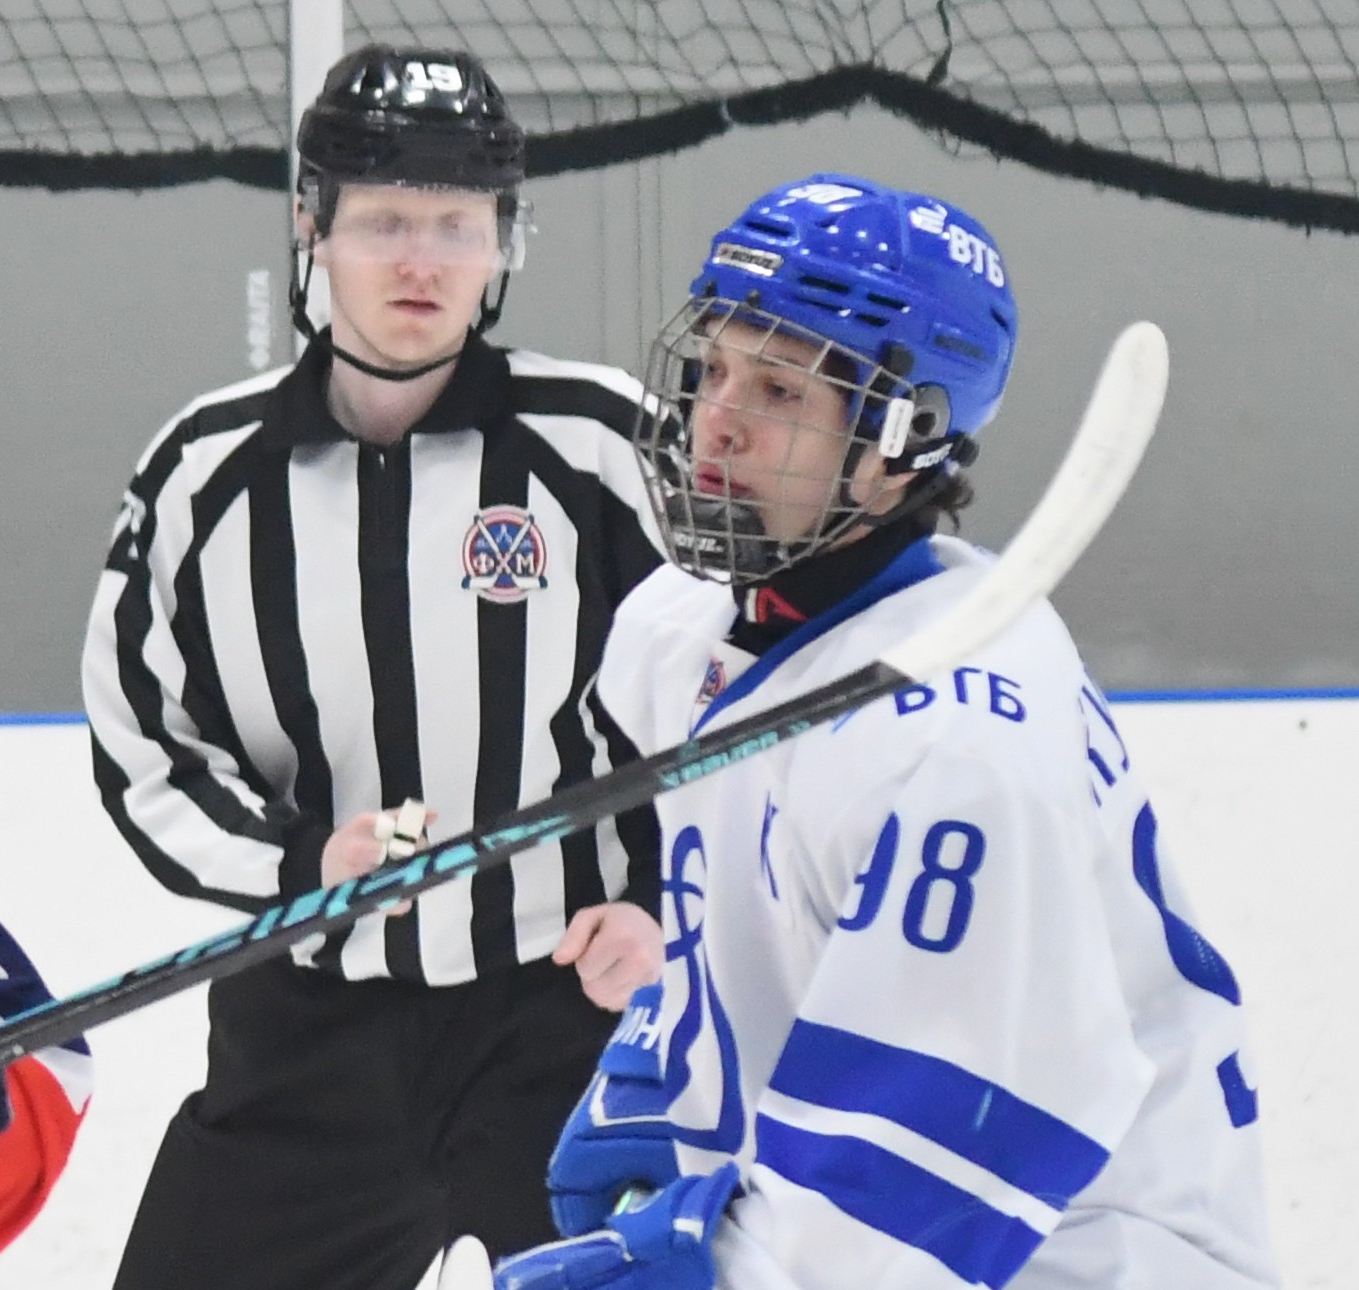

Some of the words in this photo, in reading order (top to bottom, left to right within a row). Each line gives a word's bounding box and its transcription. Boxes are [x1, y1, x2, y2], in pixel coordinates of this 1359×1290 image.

[405, 61, 463, 92] 19
[948, 223, 1005, 288] ВТБ
[472, 552, 536, 575] ФХМ
[837, 810, 986, 954] 98
